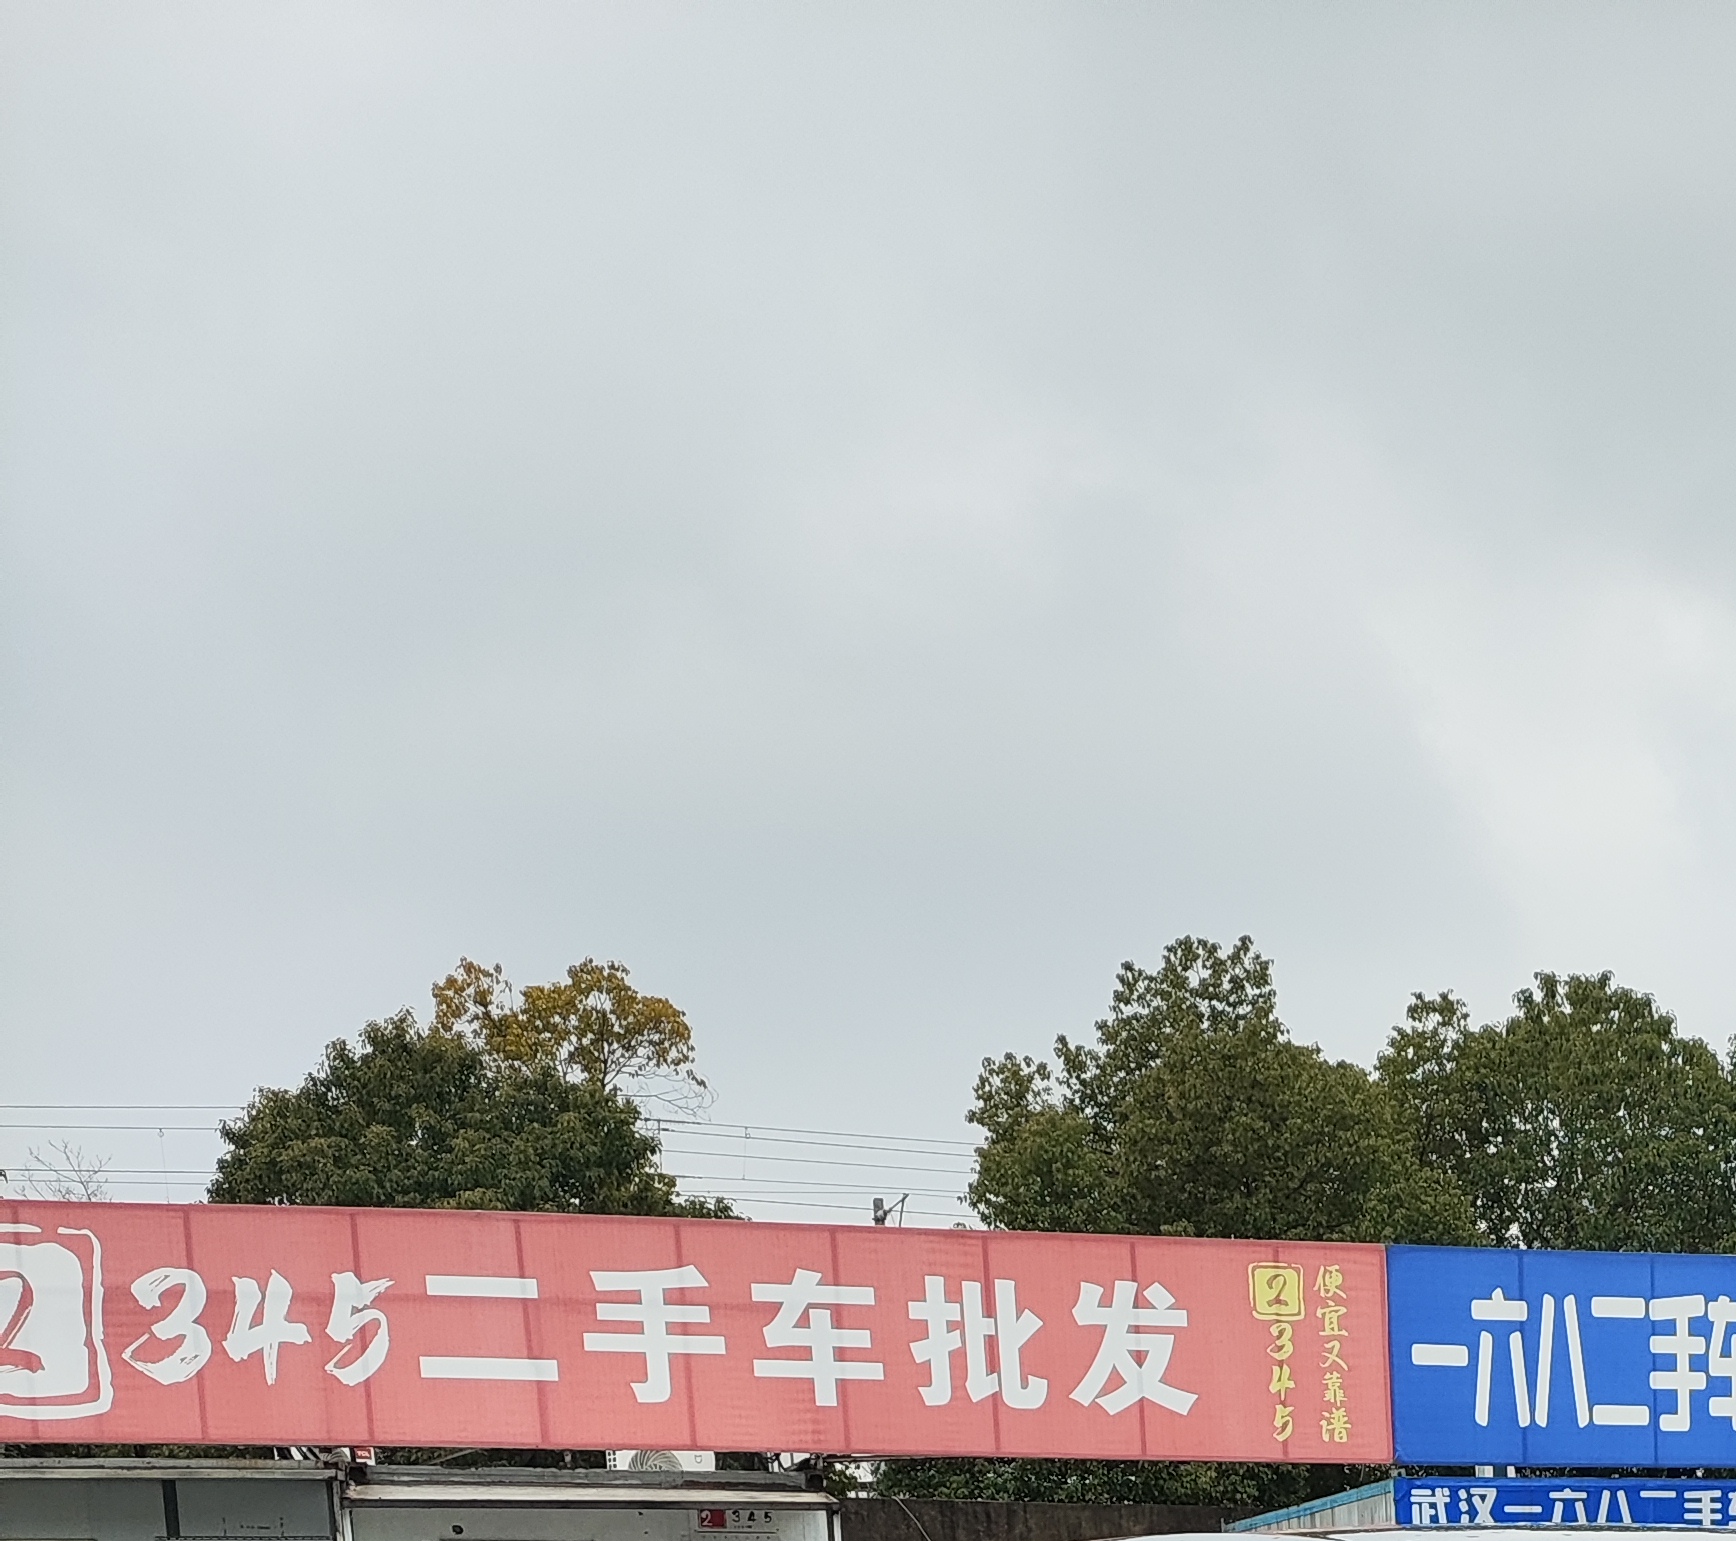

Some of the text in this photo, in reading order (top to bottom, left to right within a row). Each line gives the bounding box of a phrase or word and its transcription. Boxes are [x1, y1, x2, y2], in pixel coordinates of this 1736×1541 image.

[1266, 1273, 1296, 1442] 2345
[1313, 1264, 1351, 1443] 便宜又靠谱
